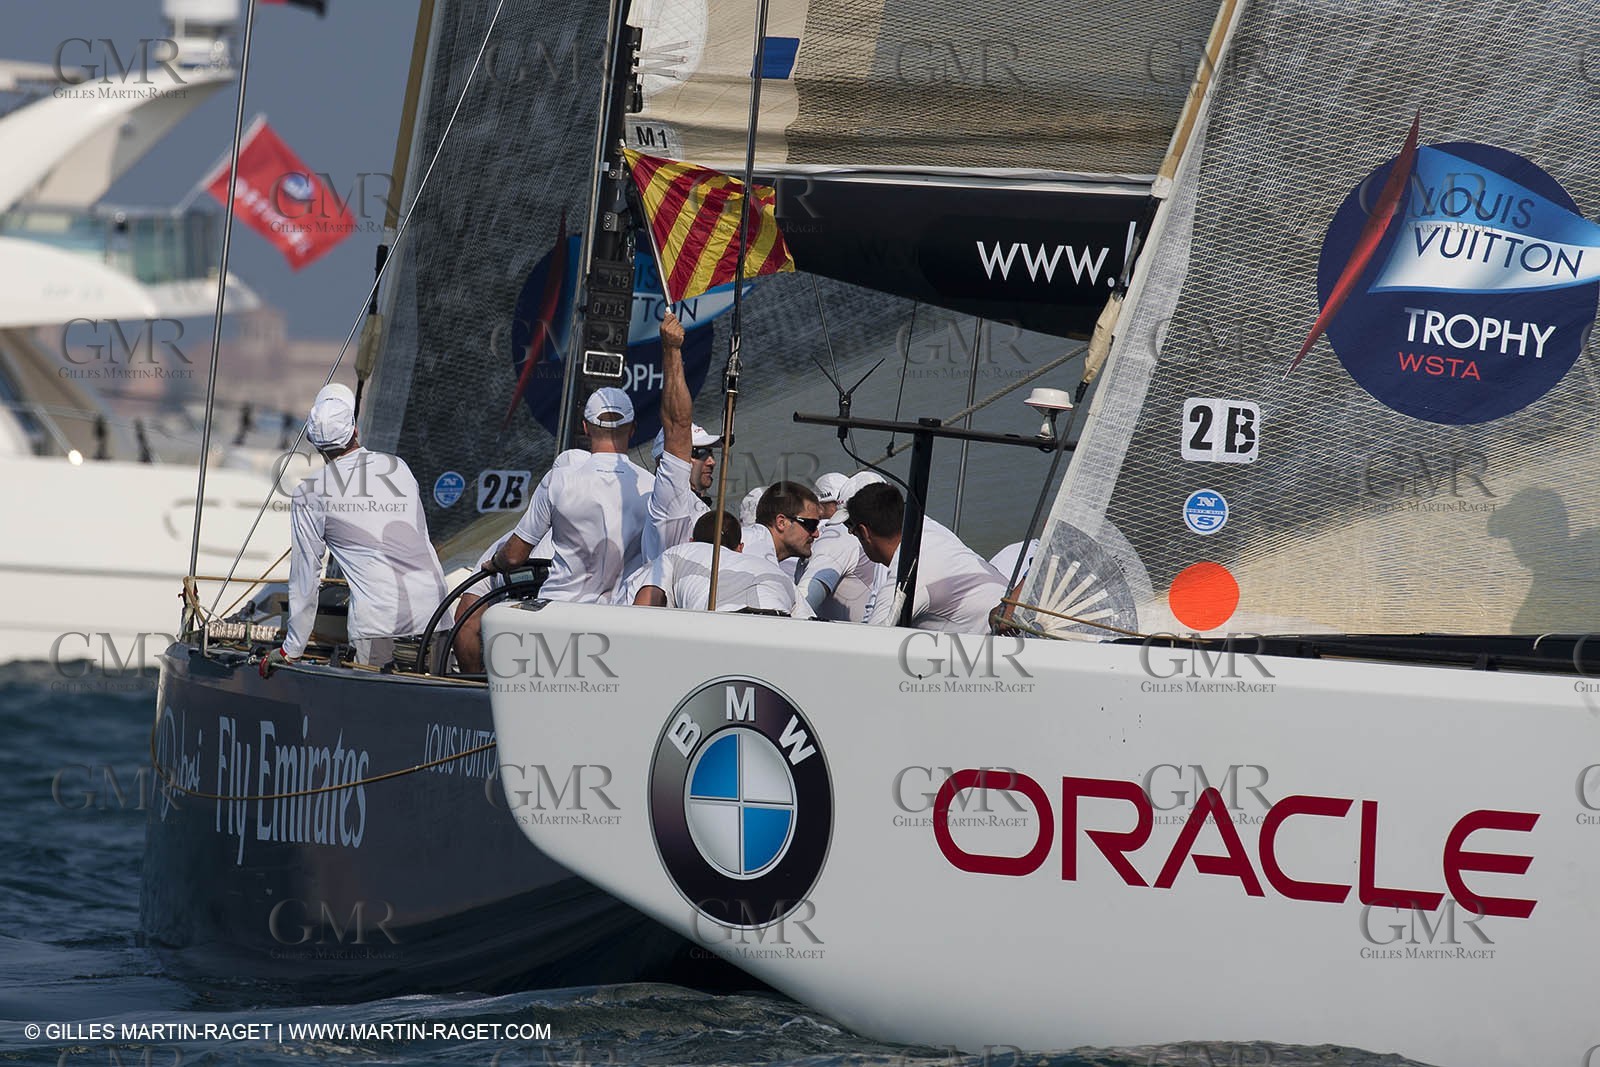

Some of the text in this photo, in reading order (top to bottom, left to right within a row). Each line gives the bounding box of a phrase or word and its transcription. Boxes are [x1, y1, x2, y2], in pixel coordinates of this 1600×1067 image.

[1421, 186, 1535, 229] LOUIS
[1414, 227, 1583, 279] VUITTON
[1403, 306, 1556, 359] TROPHY
[1398, 351, 1481, 381] WSTA
[424, 723, 457, 775] LOUIS
[667, 686, 817, 767] BMW
[216, 715, 369, 865] Fly Emirates
[933, 768, 1541, 919] ORACLE
